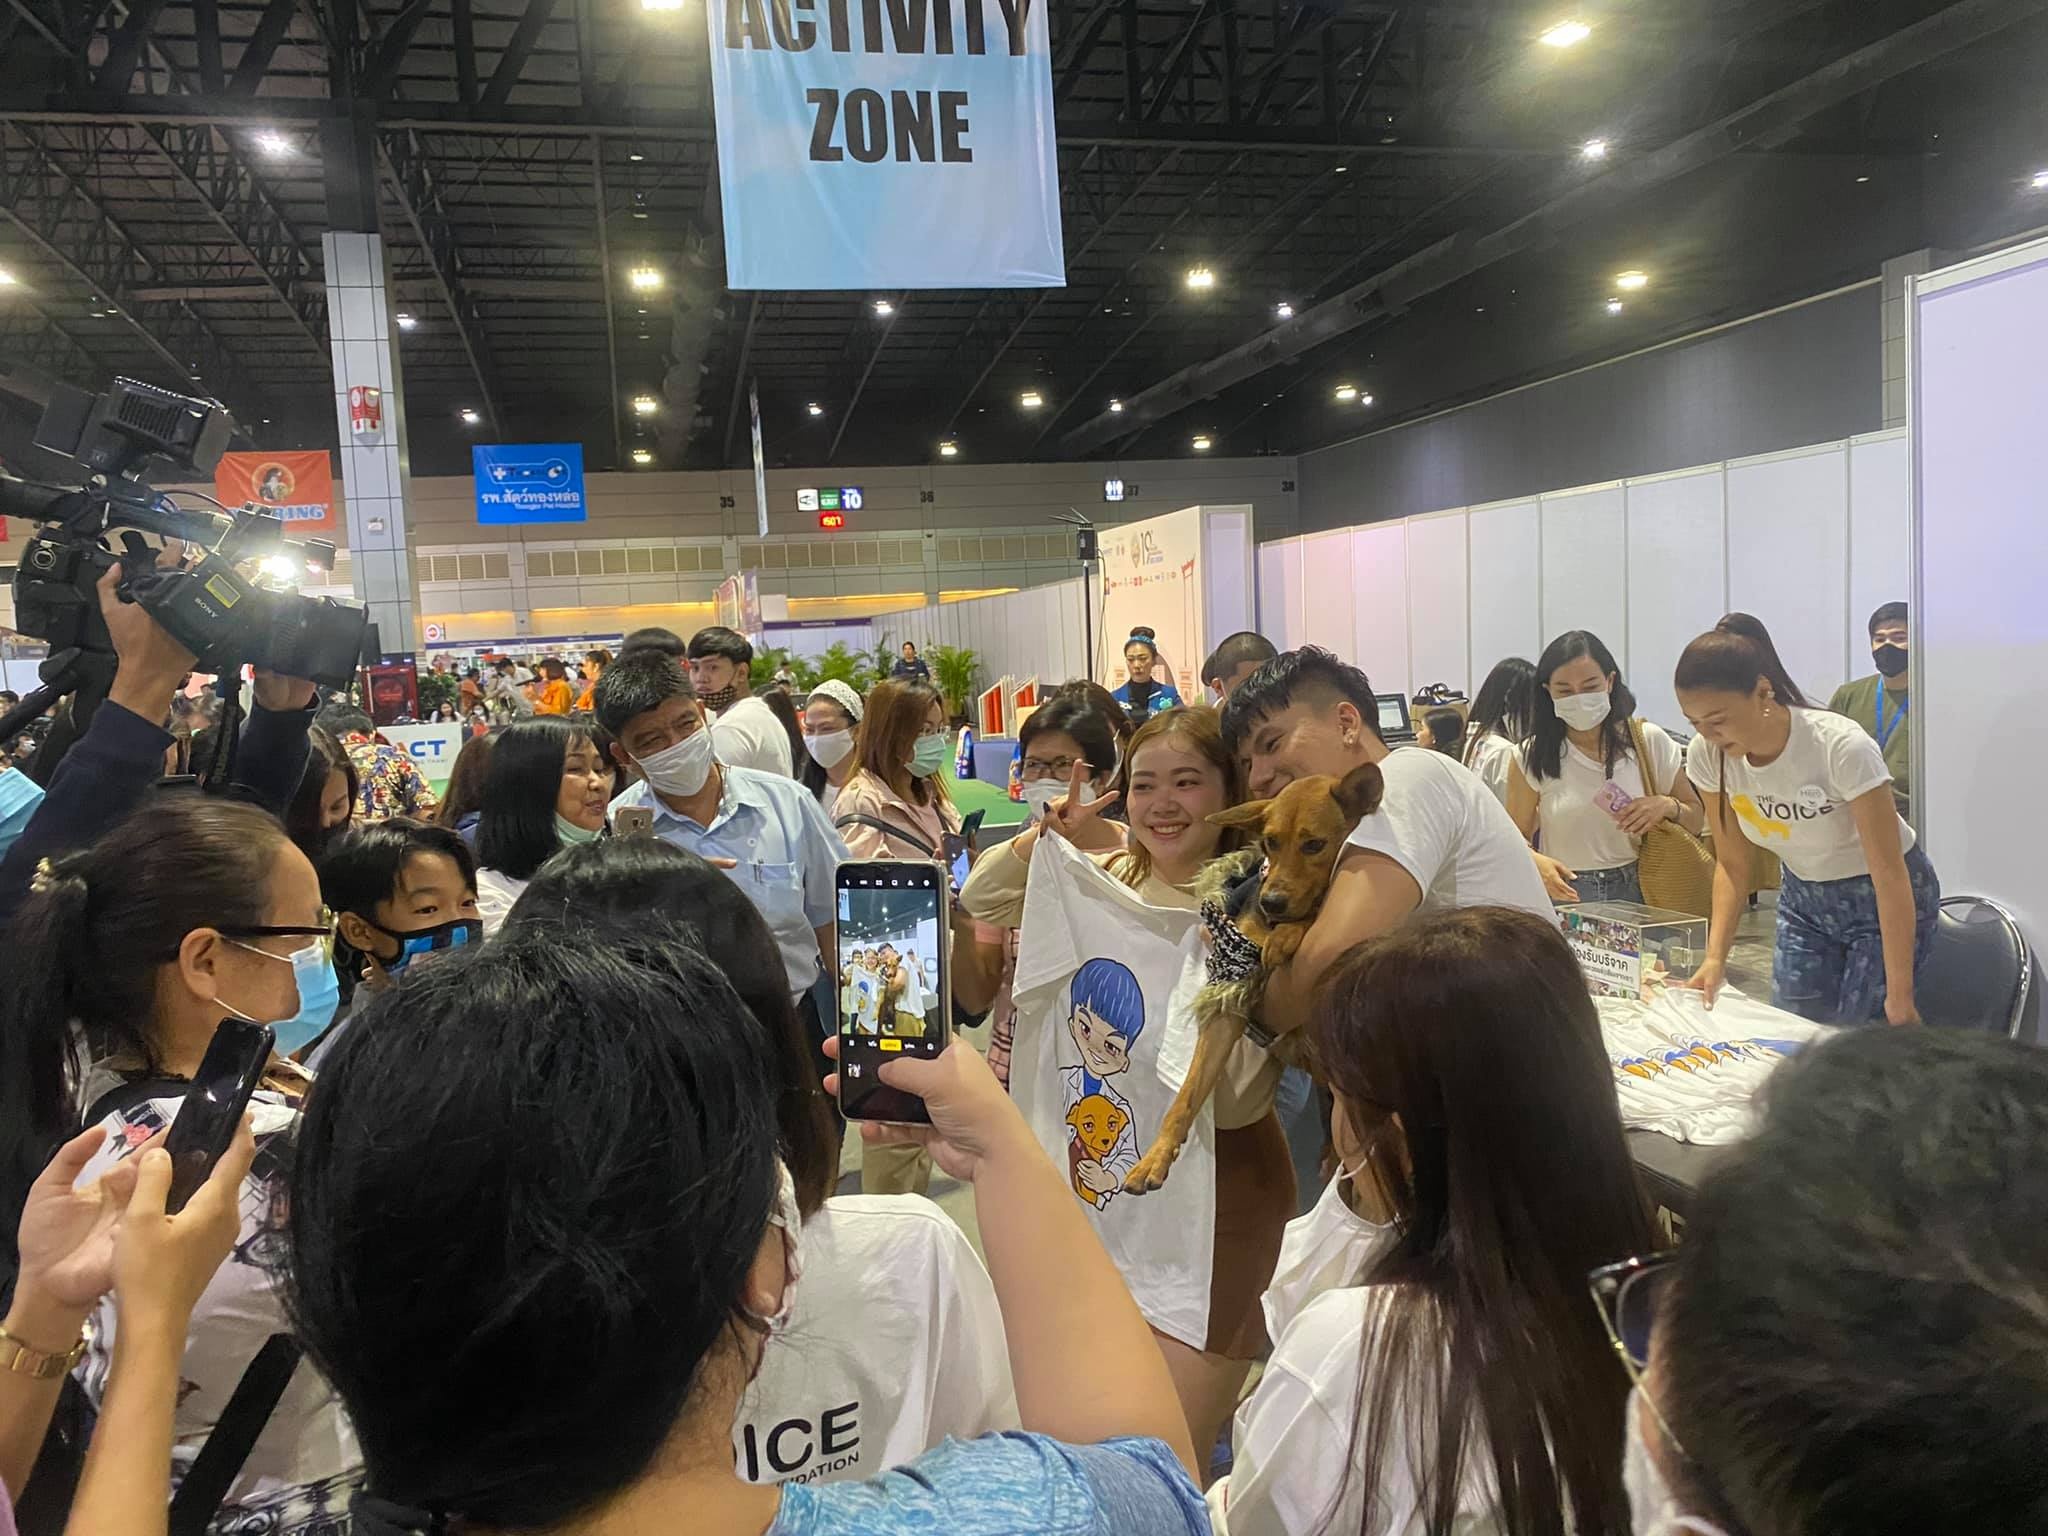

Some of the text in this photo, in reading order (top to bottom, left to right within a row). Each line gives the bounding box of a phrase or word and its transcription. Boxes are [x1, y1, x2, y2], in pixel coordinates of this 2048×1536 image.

[725, 0, 1029, 56] ACTIVITY
[806, 88, 973, 163] ZONE
[842, 493, 862, 509] 10
